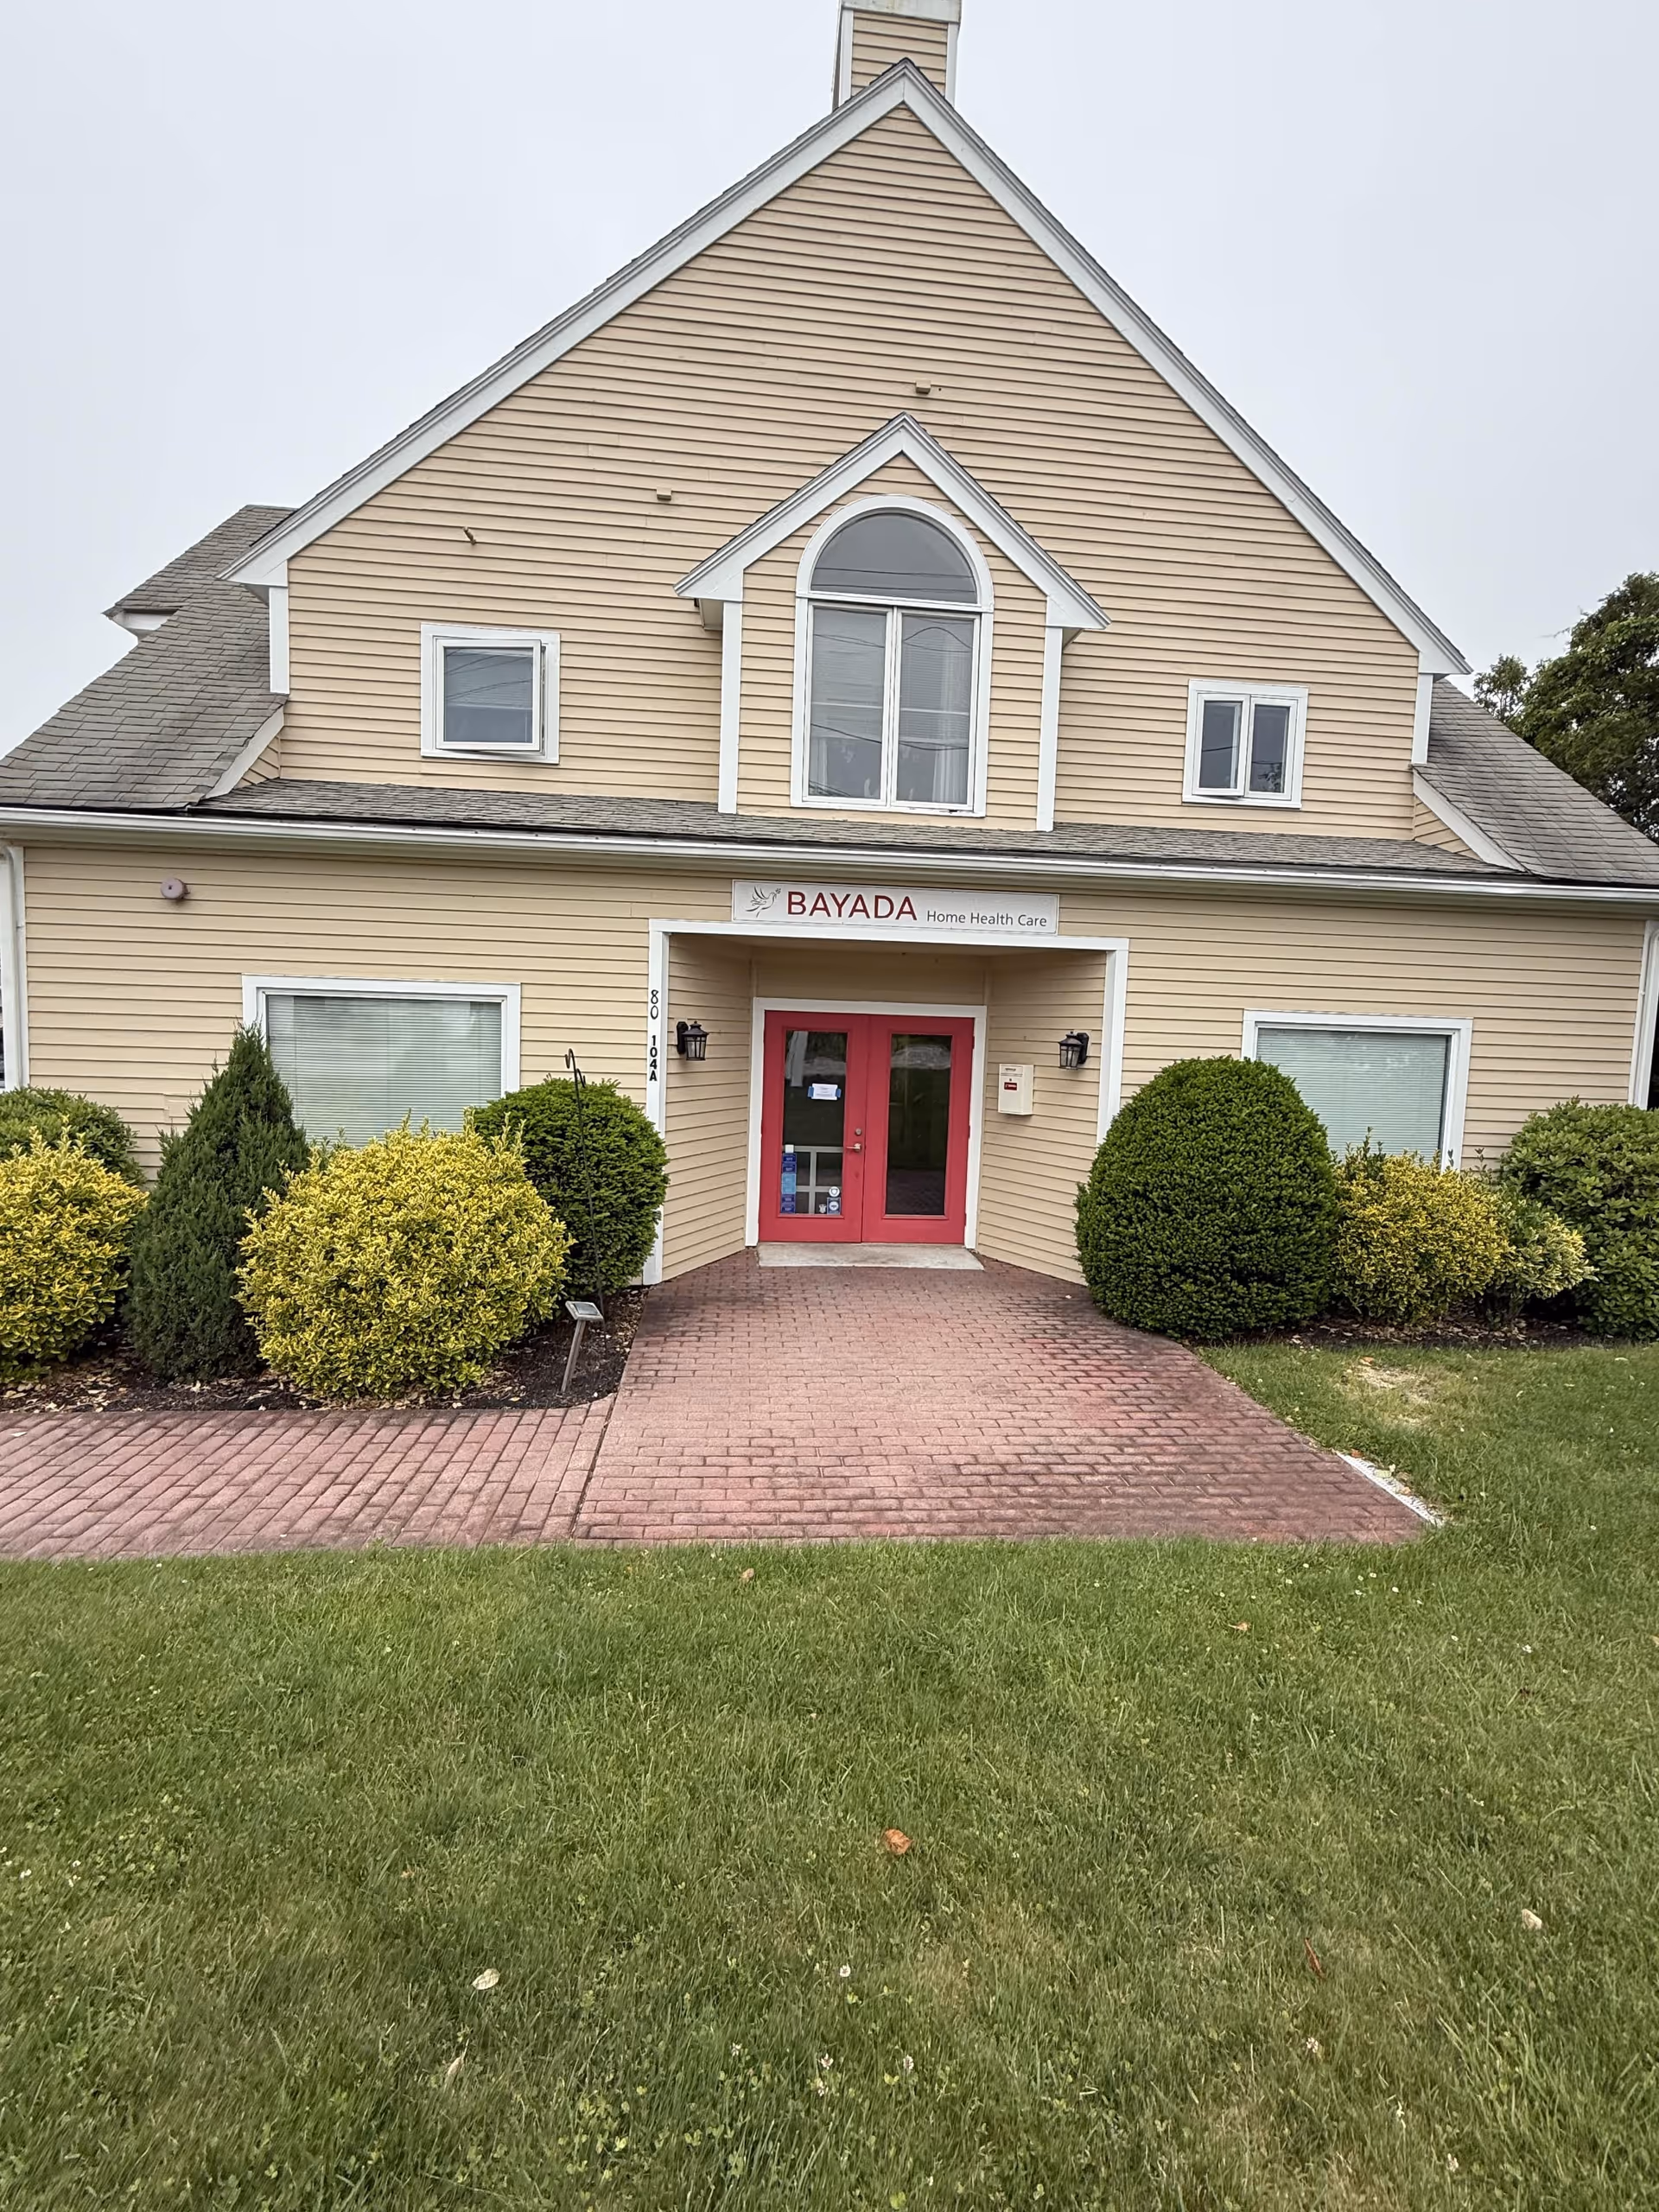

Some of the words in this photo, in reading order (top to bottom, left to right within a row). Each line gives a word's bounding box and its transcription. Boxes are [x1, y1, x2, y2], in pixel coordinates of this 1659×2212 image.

[787, 891, 918, 921] BAYADA
[926, 910, 966, 924] Home
[970, 912, 1014, 925] Health
[1018, 914, 1047, 927] Care
[650, 989, 659, 1020] 80
[649, 1035, 658, 1082] 104A
